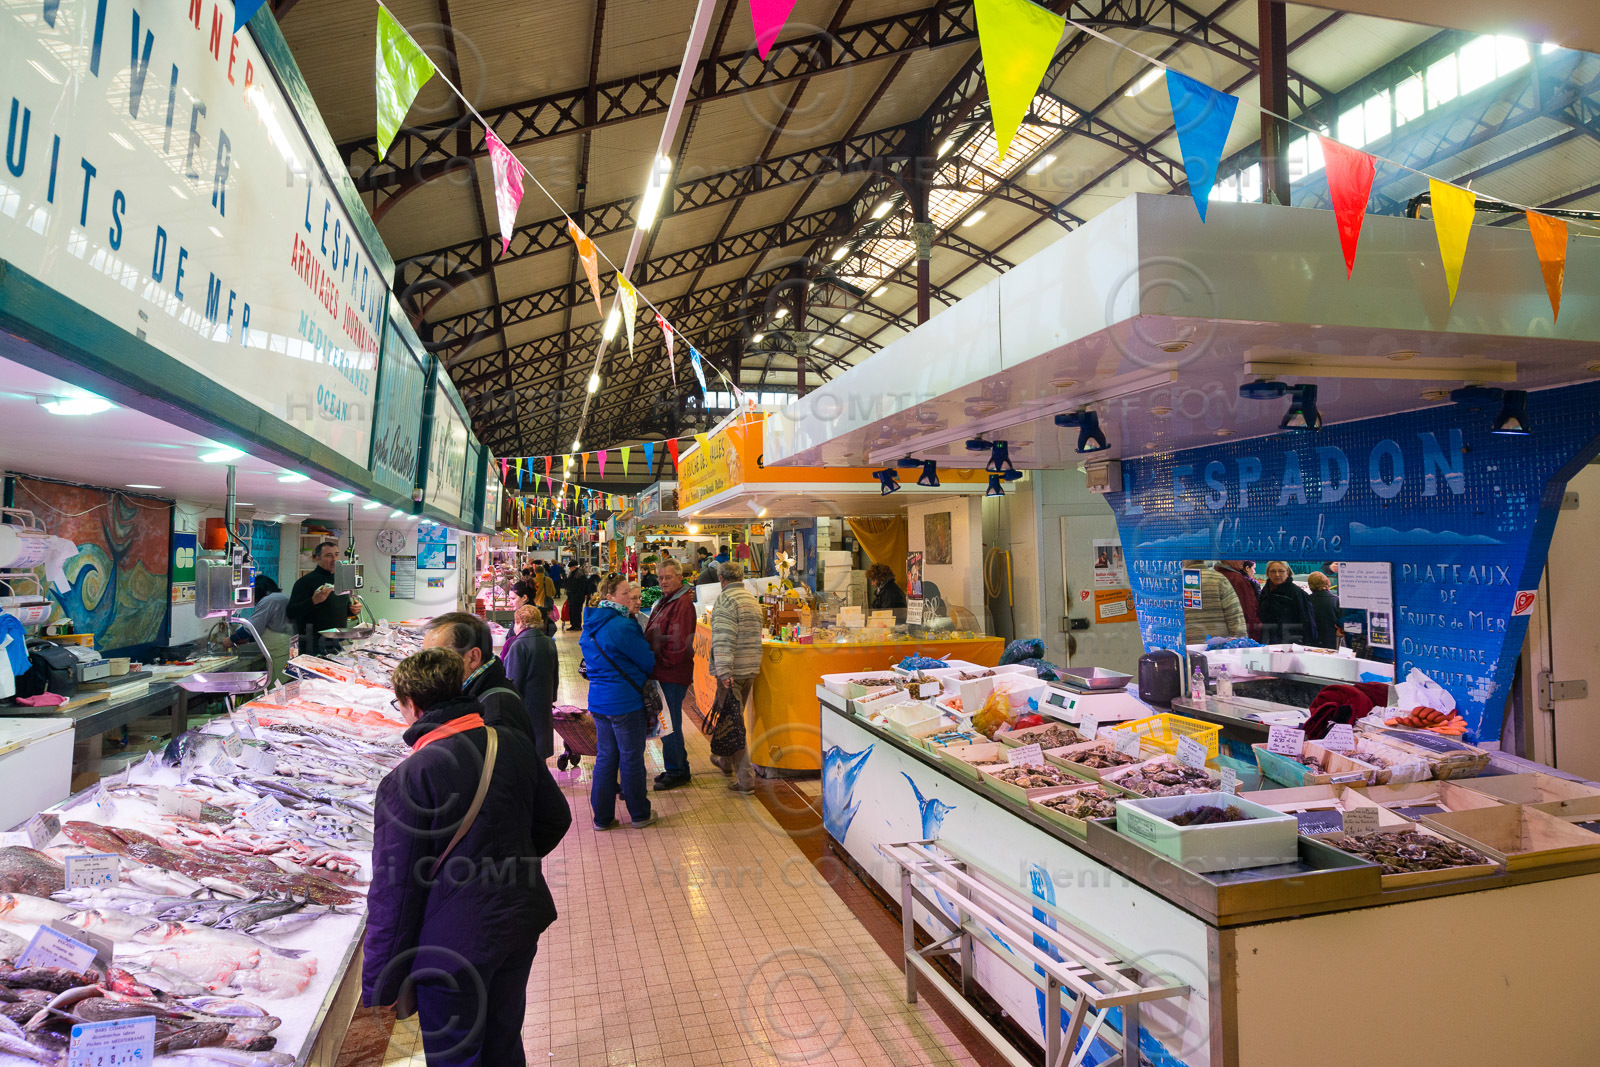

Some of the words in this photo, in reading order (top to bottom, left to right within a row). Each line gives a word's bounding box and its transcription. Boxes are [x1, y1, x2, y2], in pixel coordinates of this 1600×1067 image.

[151, 225, 189, 302] DE
[206, 271, 252, 349] MER
[291, 233, 340, 320] ARRIVAGES
[1214, 514, 1343, 556] Christophe
[1402, 563, 1511, 586] PLATEAUX
[1440, 589, 1457, 605] DE
[1399, 605, 1446, 628] FRUITS
[1450, 618, 1464, 630] de
[1468, 610, 1507, 633] MER
[1401, 637, 1487, 665] OUVERTURE
